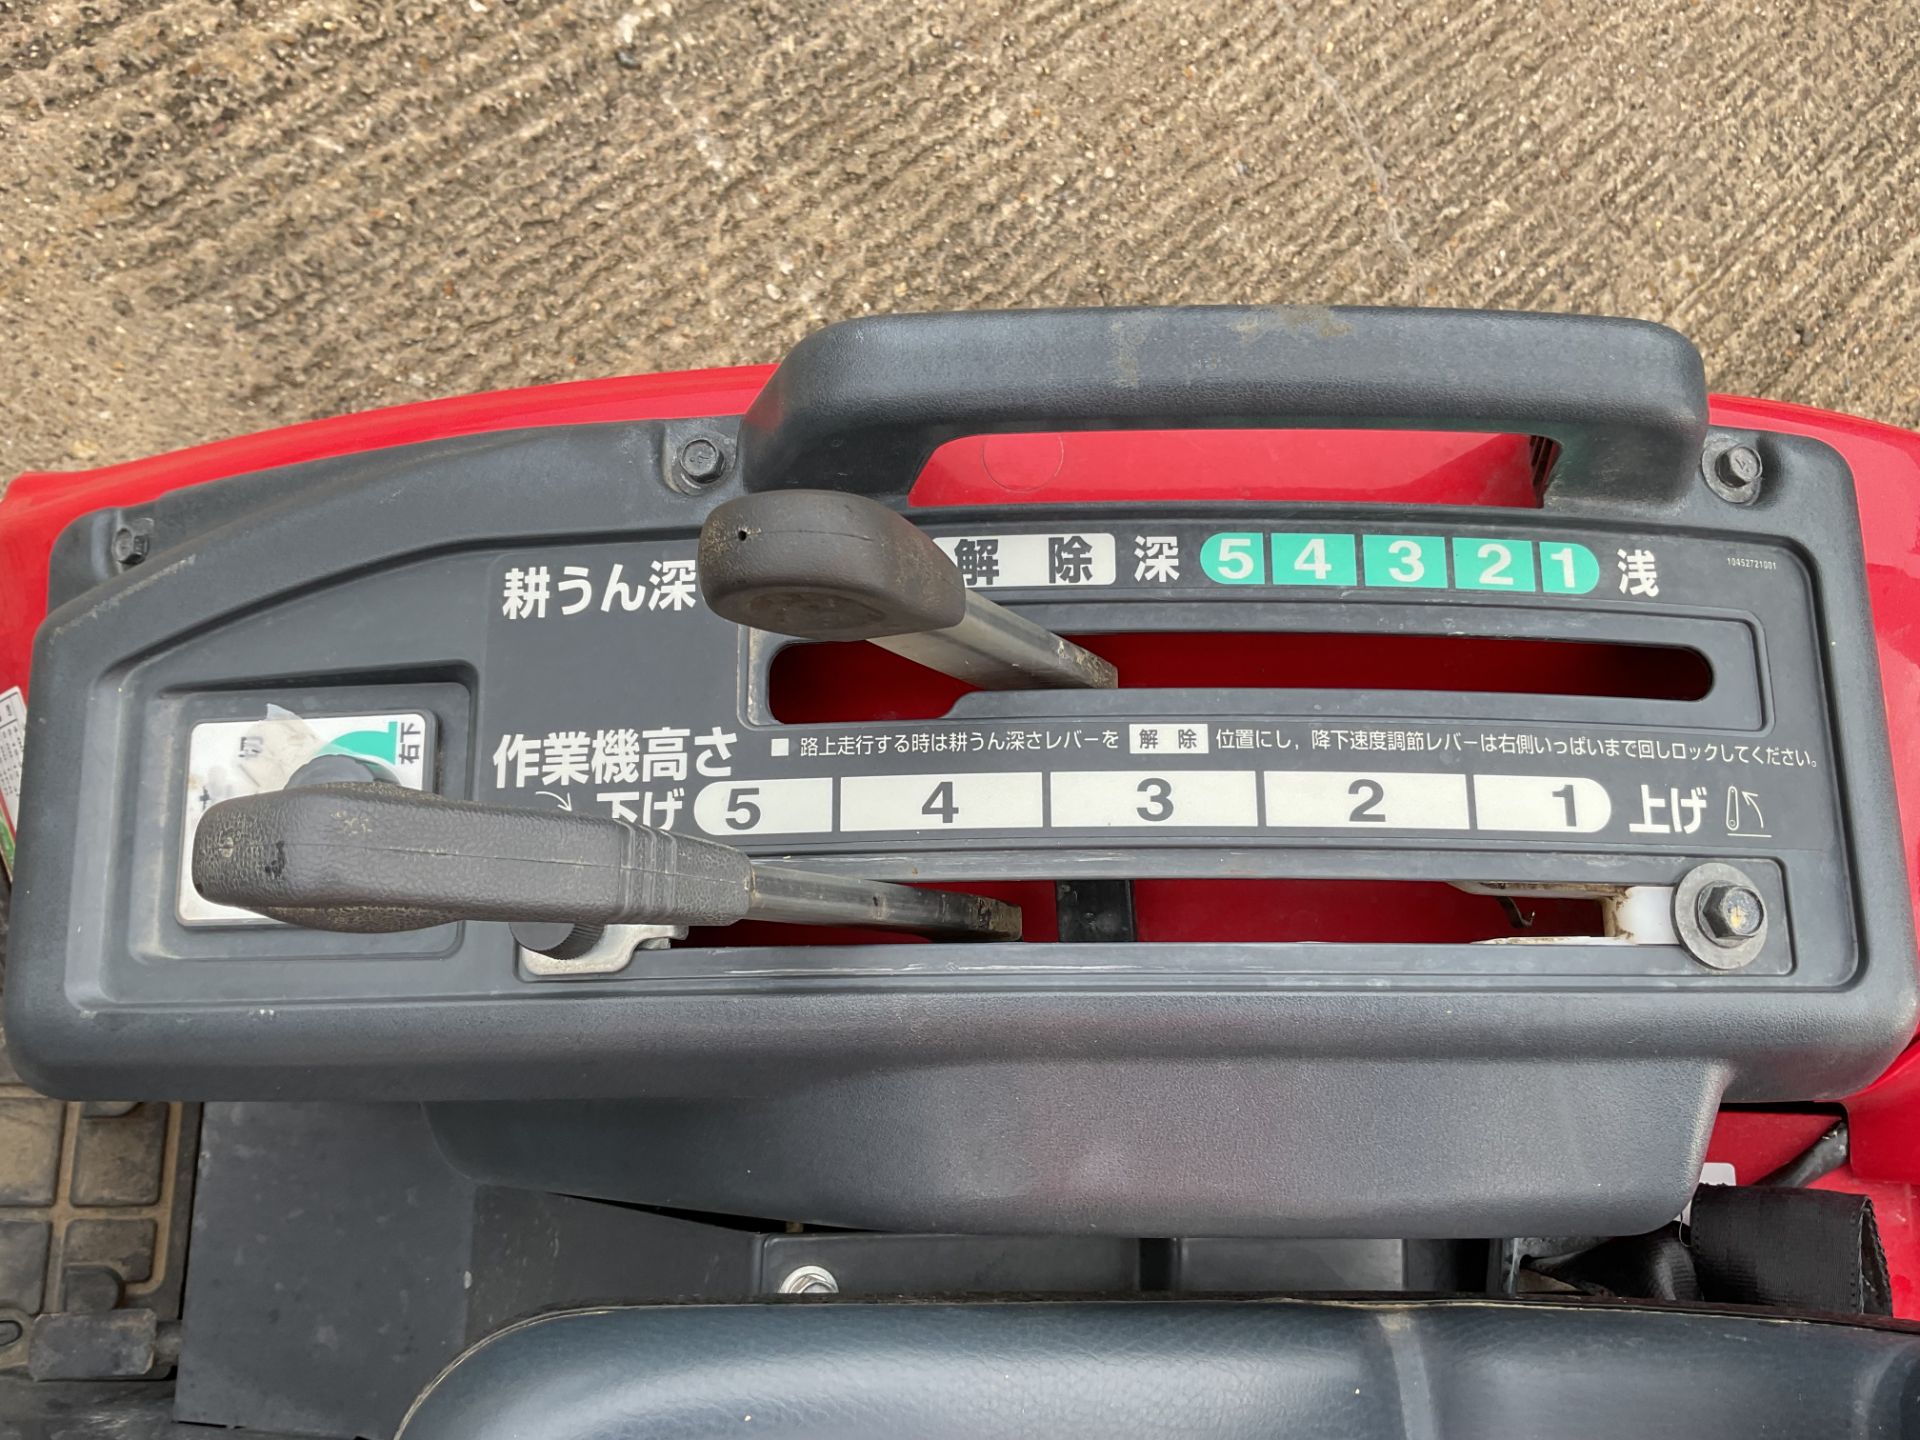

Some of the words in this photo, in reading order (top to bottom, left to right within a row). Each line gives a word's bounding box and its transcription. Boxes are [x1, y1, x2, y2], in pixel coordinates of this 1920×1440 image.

[502, 560, 697, 619] 耕うん深
[1134, 535, 1180, 583] 深
[1218, 538, 1254, 580] 5
[1294, 538, 1332, 580] 4
[1388, 540, 1425, 583] 3
[1477, 543, 1514, 586] 2
[1550, 547, 1577, 589] 1
[1617, 548, 1660, 597] 浅
[398, 722, 422, 765] 右下
[492, 726, 738, 789] 作業機高さ
[800, 730, 1119, 757] 路上走行する時は耕うん深さレバーを
[725, 787, 761, 831] 5
[921, 781, 960, 824] 4
[1136, 777, 1175, 822] 3
[1347, 778, 1386, 823] 2
[1552, 784, 1577, 827] 1
[1628, 784, 1708, 835] 上げ
